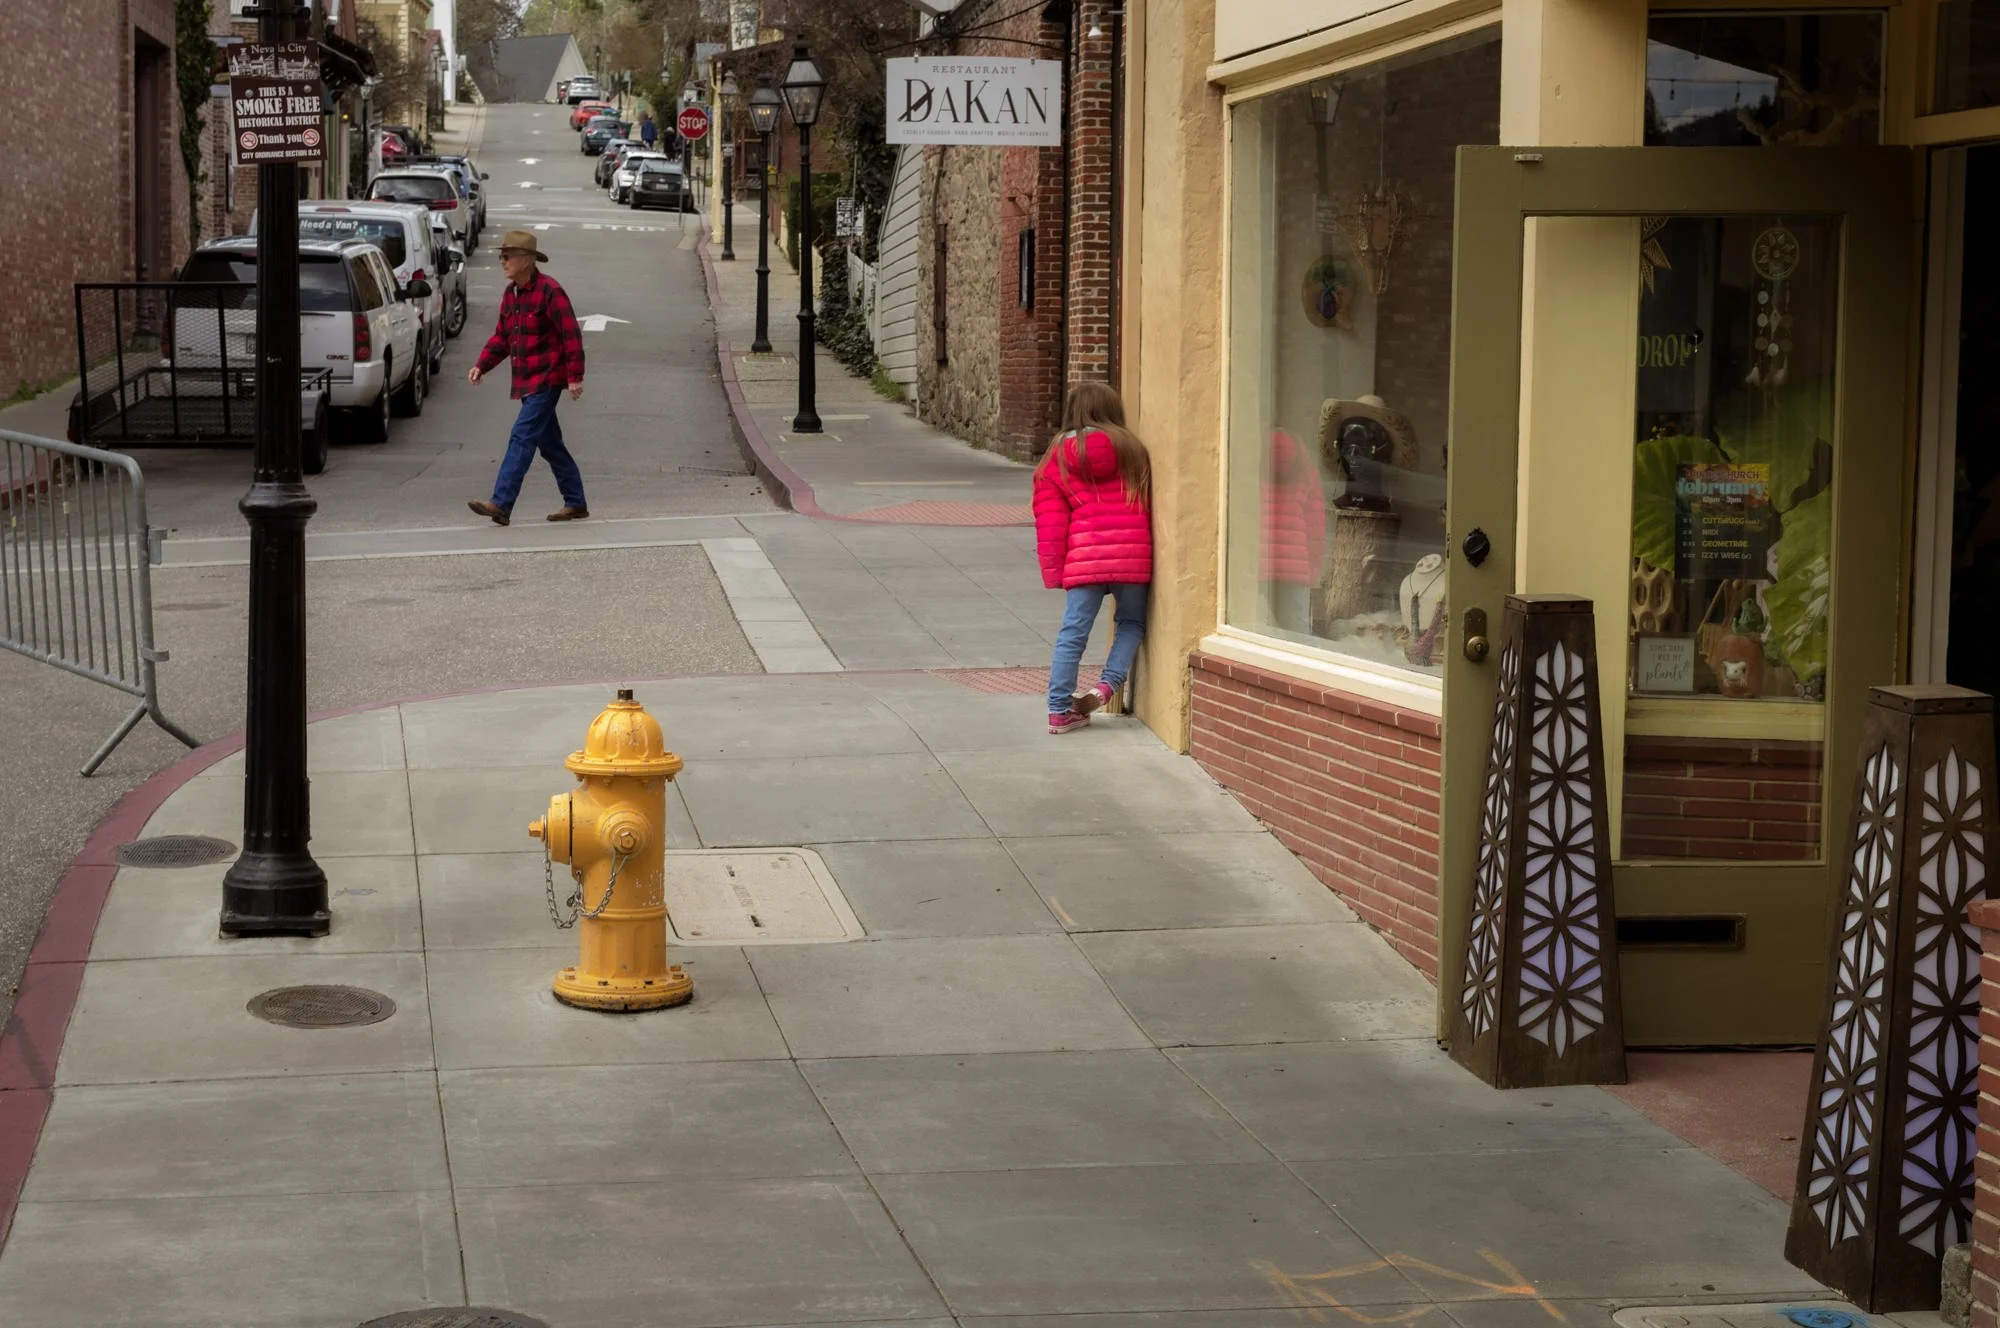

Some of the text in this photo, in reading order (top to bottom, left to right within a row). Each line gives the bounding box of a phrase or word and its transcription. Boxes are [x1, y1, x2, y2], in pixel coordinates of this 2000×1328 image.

[287, 42, 307, 54] City
[932, 65, 1017, 75] RESTAURANT
[258, 86, 294, 97] THIS IS A
[235, 96, 320, 116] SMOKE FREE
[897, 78, 1048, 124] DAKAN
[237, 115, 320, 128] HISTORICAL DISTRICT
[679, 116, 707, 129] STOP
[258, 133, 302, 145] Thank you
[241, 151, 254, 159] CITY
[254, 150, 284, 159] ORDINANCE
[285, 149, 308, 158] SECTION
[300, 219, 326, 229] Need
[326, 221, 332, 229] a
[335, 220, 359, 230] Van?
[1676, 477, 1764, 500] february
[1646, 662, 1683, 682] plants
